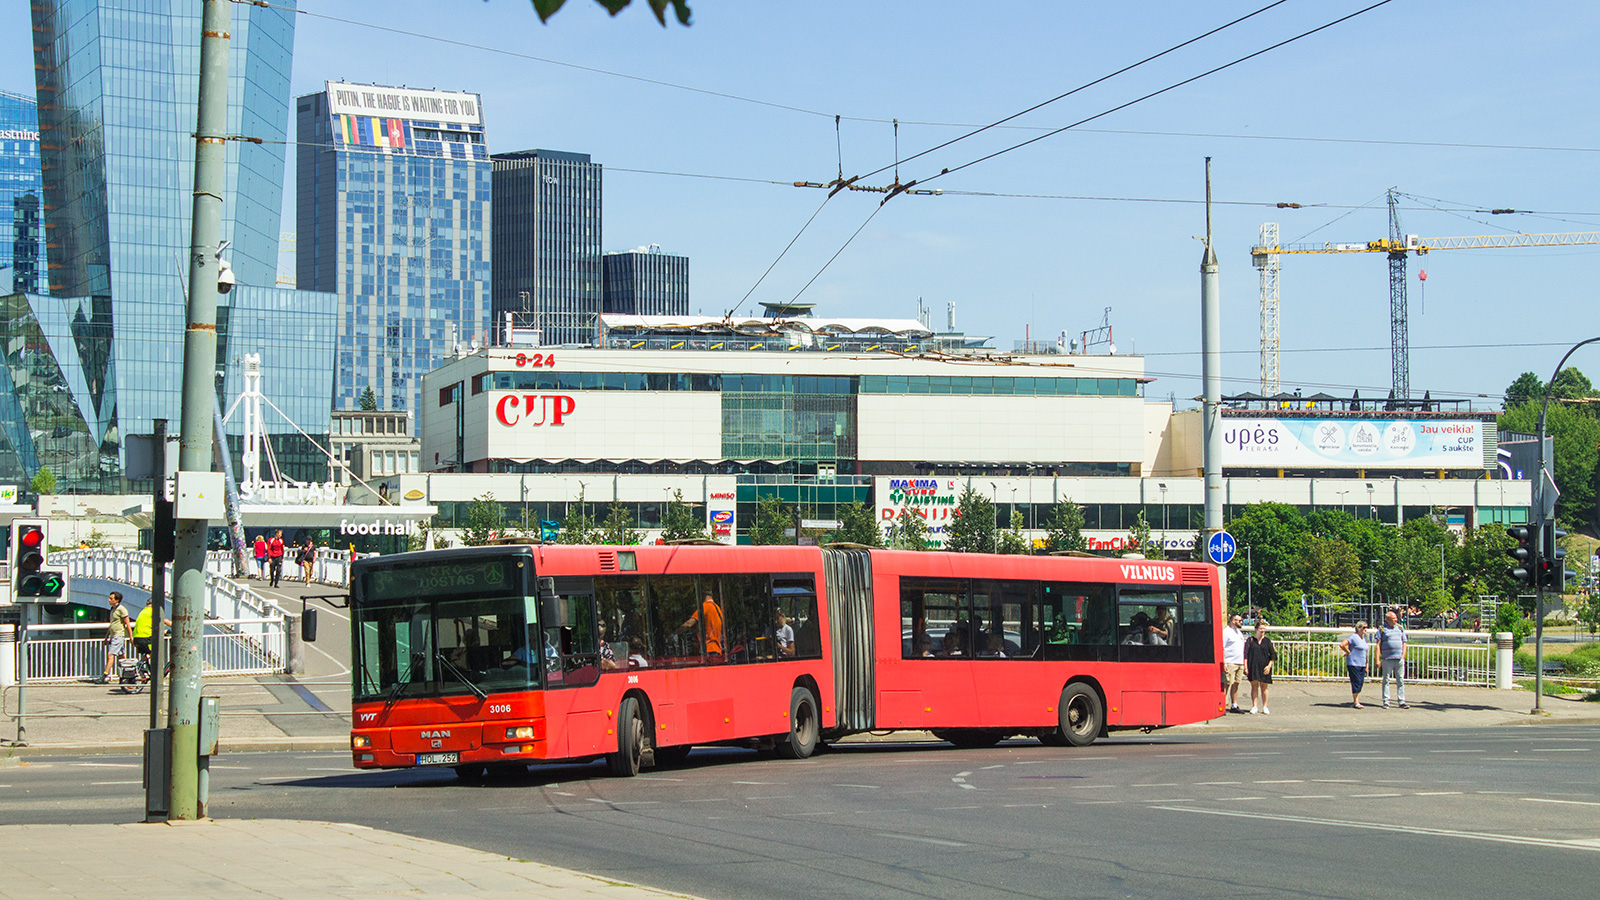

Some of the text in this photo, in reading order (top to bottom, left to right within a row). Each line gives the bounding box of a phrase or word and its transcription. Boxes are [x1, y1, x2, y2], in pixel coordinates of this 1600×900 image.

[336, 89, 475, 116] PUTIN, THE HAGUE IS WAITING FOR YOU
[516, 353, 555, 367] 8-24
[495, 394, 576, 426] CUP
[1420, 424, 1474, 434] Jau veikia!
[1225, 423, 1279, 451] upės
[1449, 444, 1474, 452] aukšte
[1517, 471, 1523, 480] 5
[890, 479, 938, 488] MAXIMA
[258, 481, 336, 500] TILTAS
[906, 494, 955, 505] VAISTINĖ
[340, 519, 415, 536] food hall
[1120, 565, 1175, 581] VILNIUS
[489, 704, 512, 714] 3006
[420, 730, 451, 739] MAN
